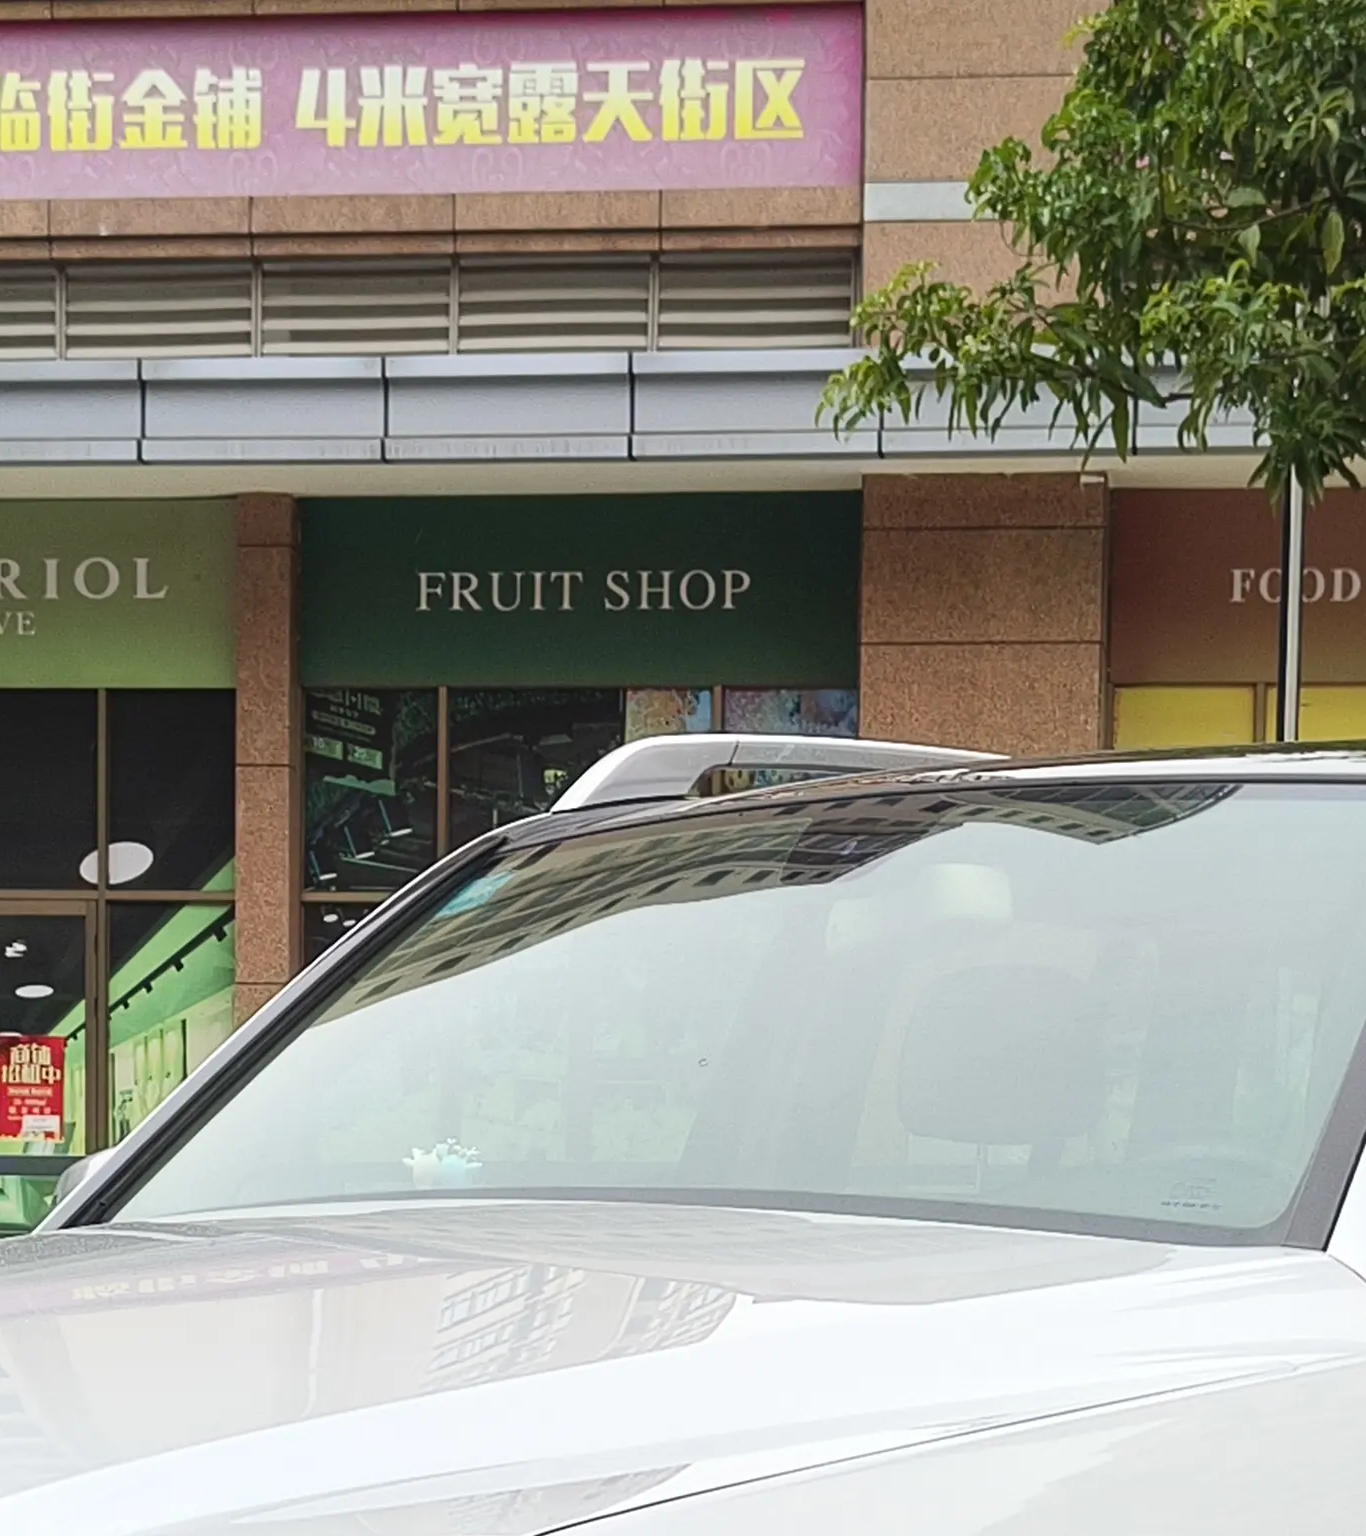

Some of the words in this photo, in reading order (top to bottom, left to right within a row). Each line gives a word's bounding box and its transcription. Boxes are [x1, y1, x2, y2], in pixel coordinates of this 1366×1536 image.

[295, 58, 806, 147] 4米宽露天街区
[415, 570, 584, 612] FRUIT
[603, 568, 752, 611] SHOP
[1229, 567, 1362, 603] FOOD
